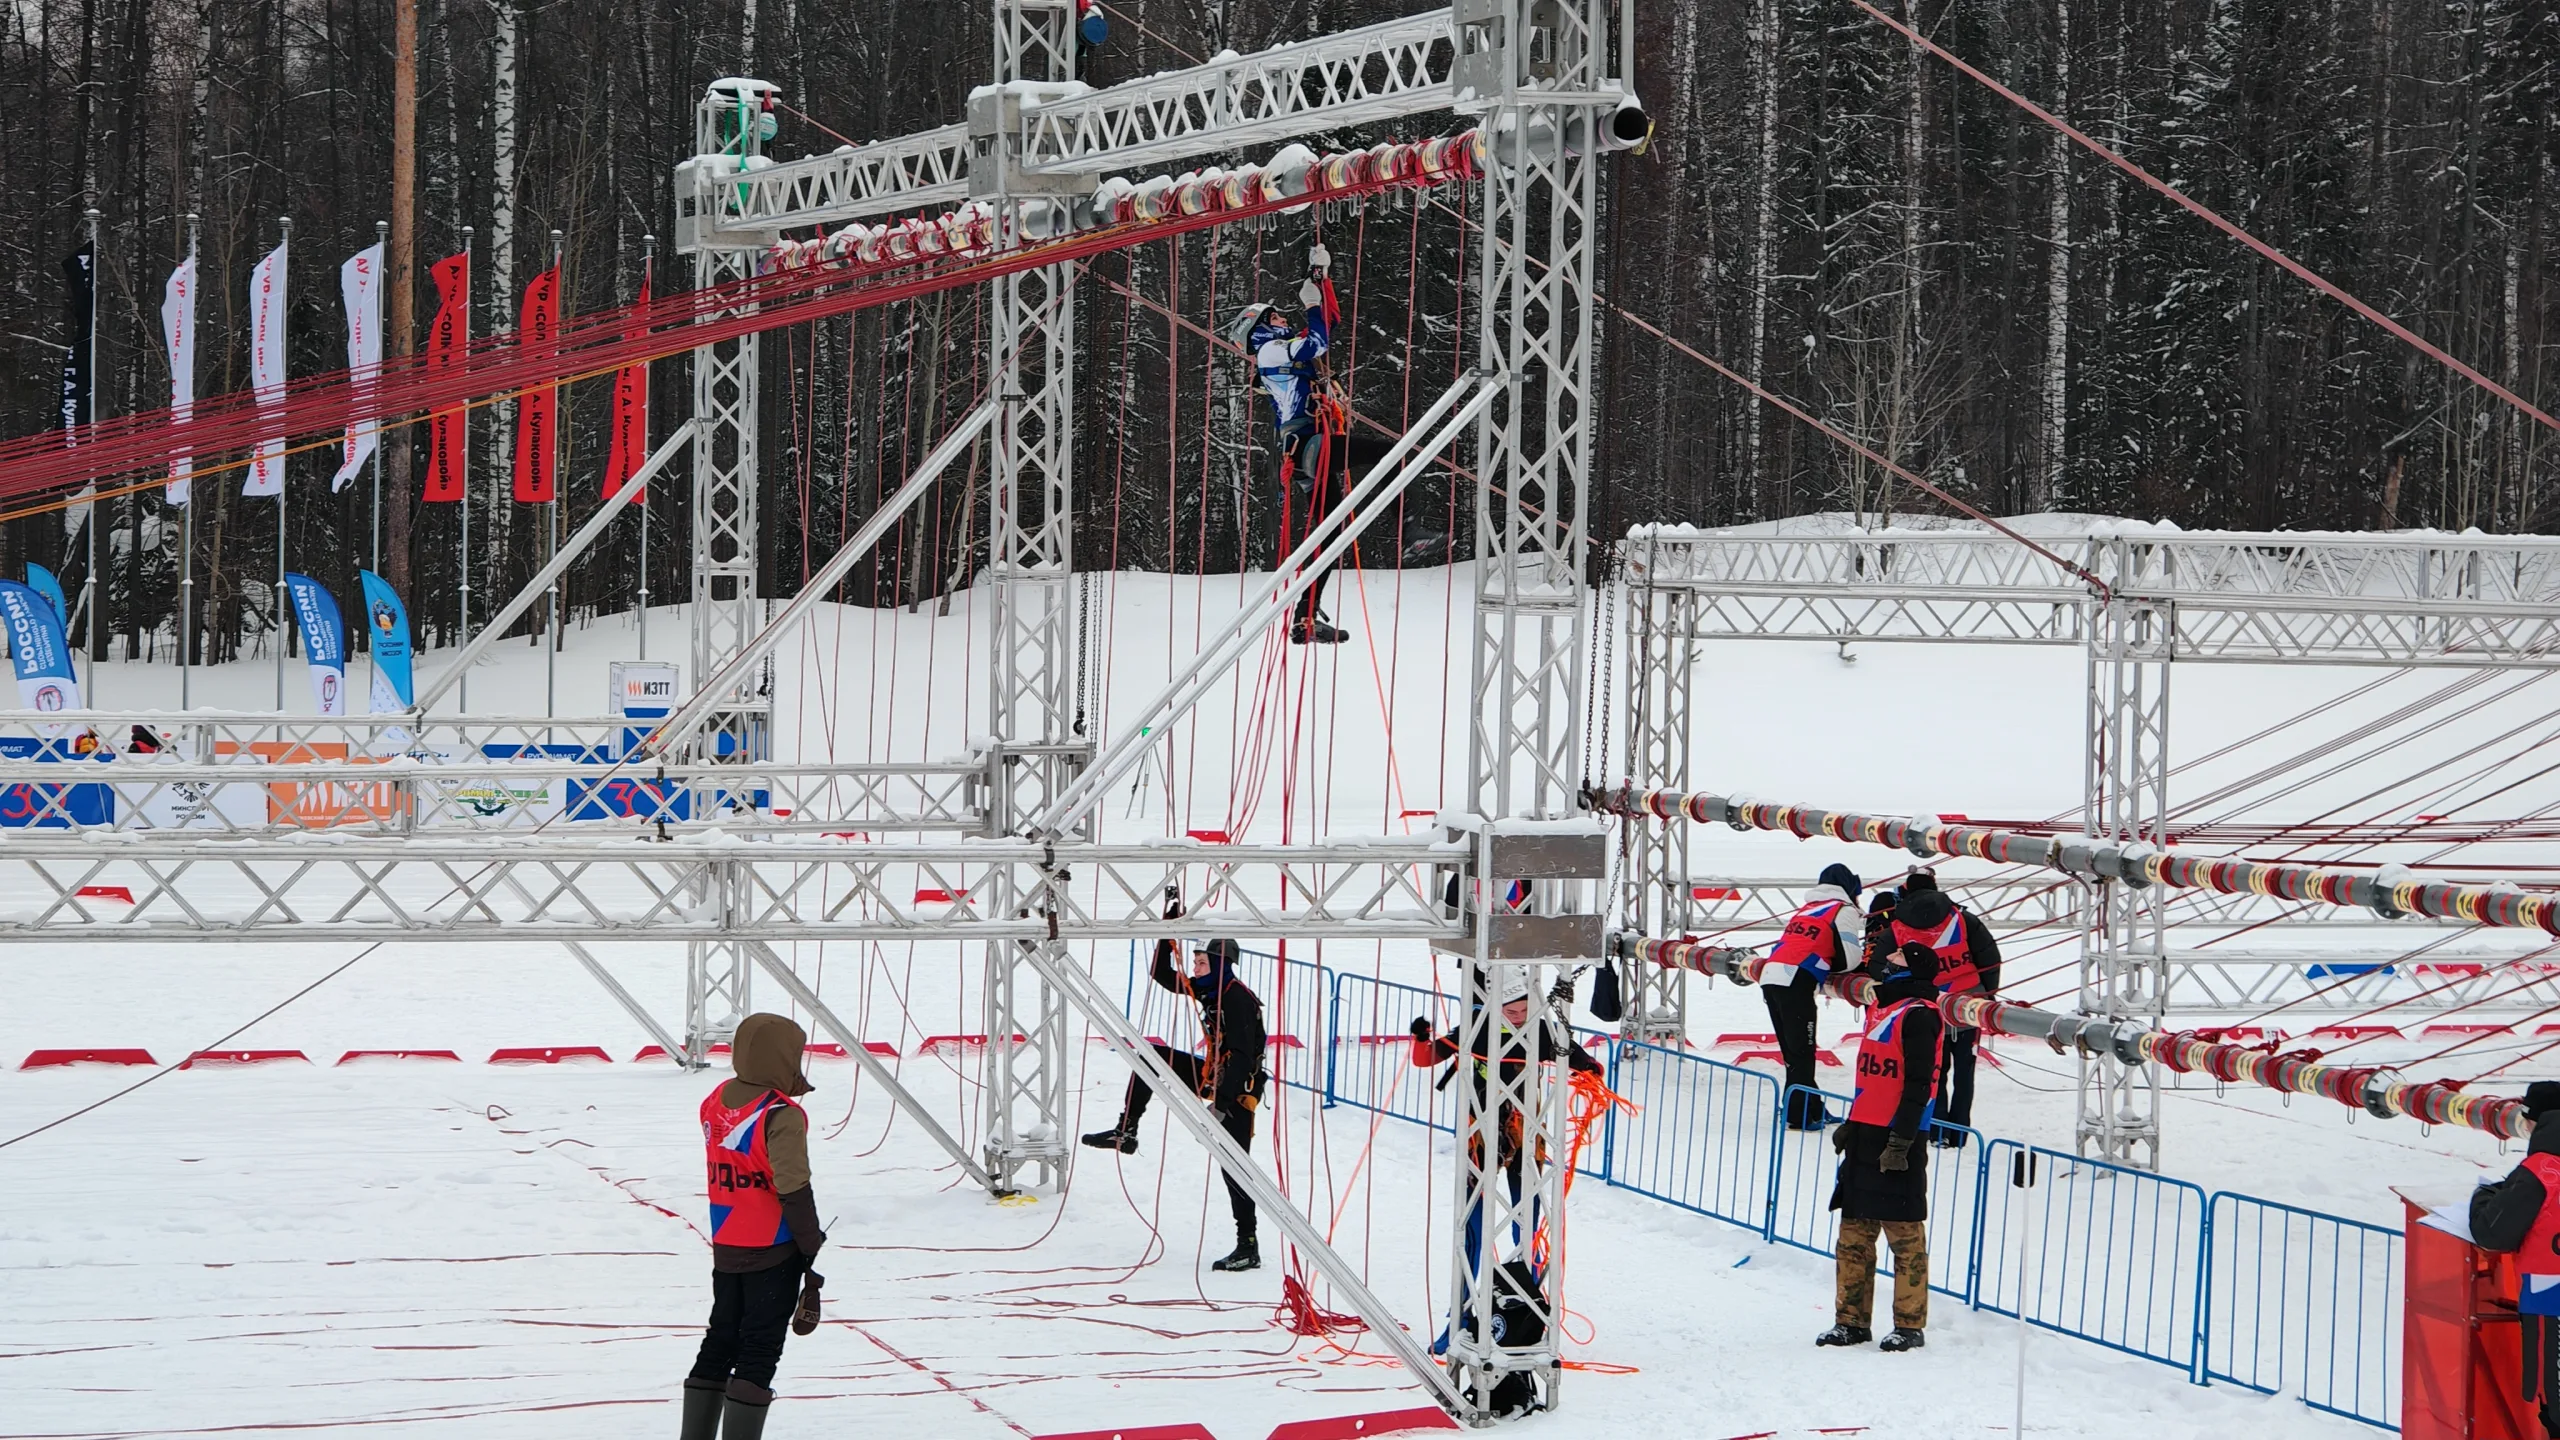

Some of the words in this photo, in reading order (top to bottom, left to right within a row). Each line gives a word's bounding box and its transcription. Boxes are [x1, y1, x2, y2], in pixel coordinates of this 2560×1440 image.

[355, 257, 370, 275] АУ
[64, 367, 76, 377] Г.
[64, 380, 77, 395] А.
[622, 398, 632, 412] А.
[530, 411, 544, 492] Кулаковой»
[643, 681, 670, 695] ИЭТТ
[2306, 875, 2323, 901] 12
[2395, 884, 2412, 909] 13
[2520, 900, 2537, 926] 15
[1784, 921, 1822, 941] ДЬЯ
[1939, 951, 1971, 974] ДЬЯ
[1859, 1052, 1899, 1080] ДЬЯ
[707, 1161, 773, 1194] УДЬЯ
